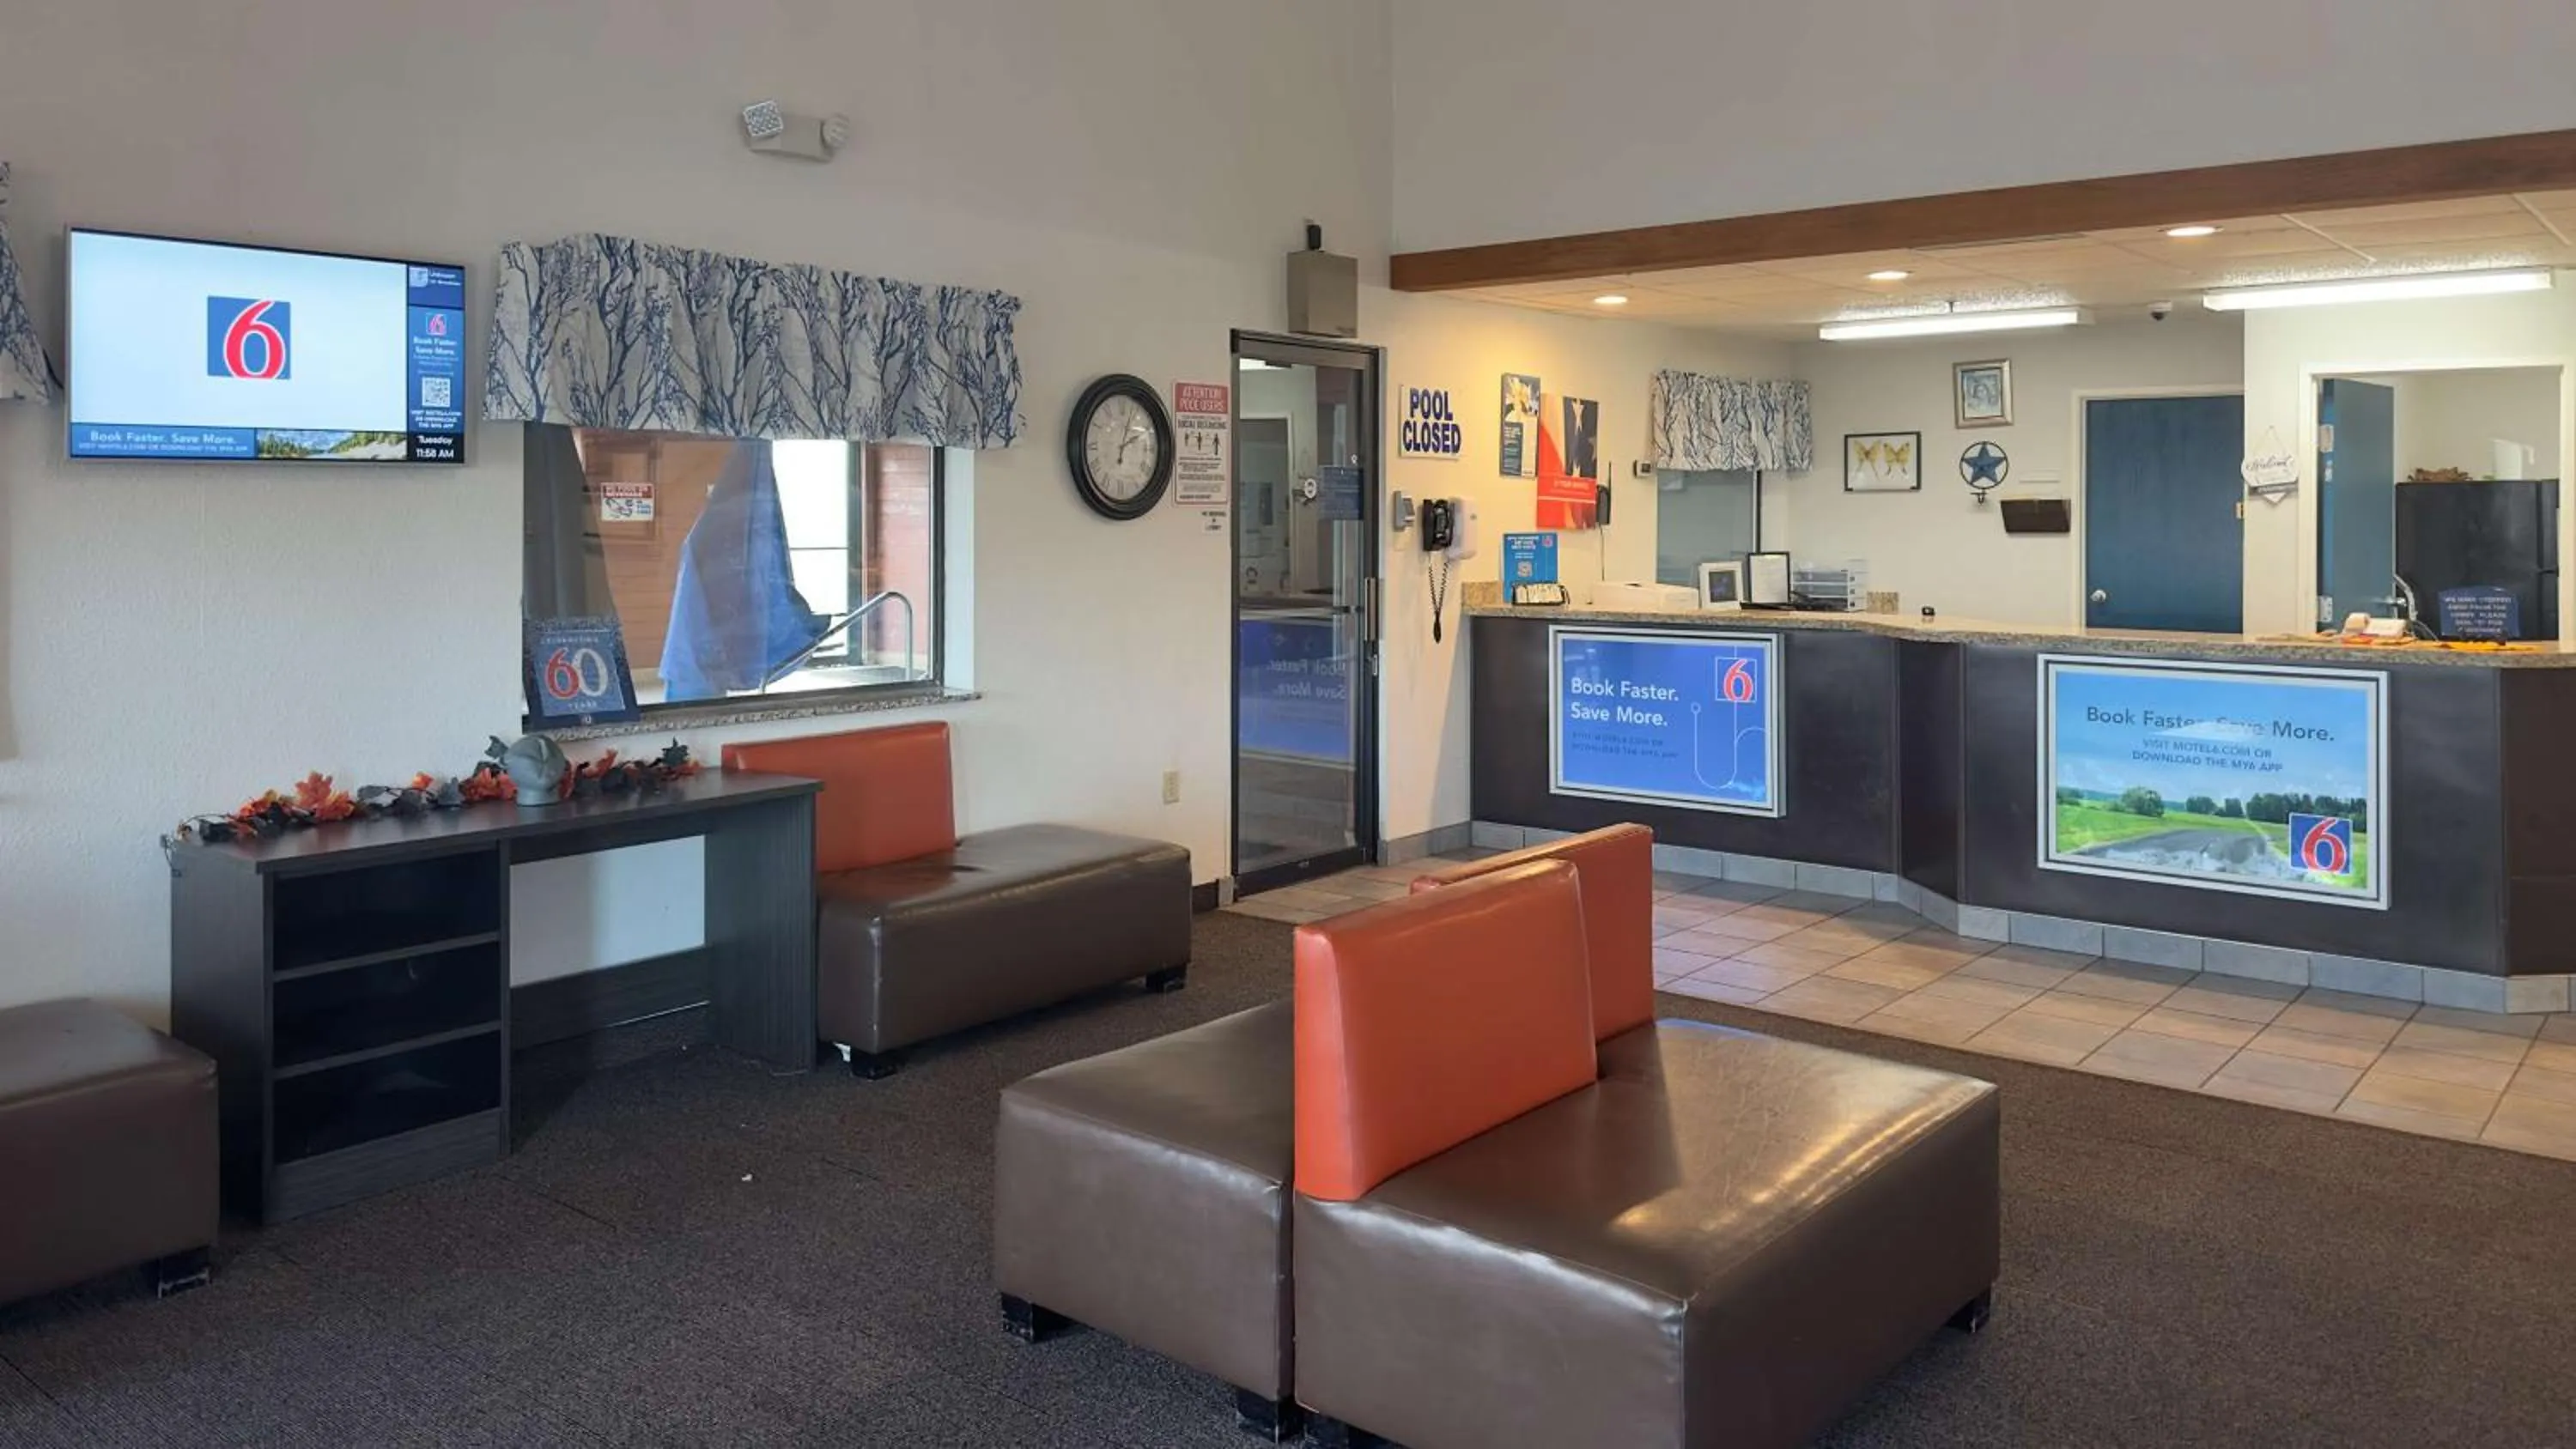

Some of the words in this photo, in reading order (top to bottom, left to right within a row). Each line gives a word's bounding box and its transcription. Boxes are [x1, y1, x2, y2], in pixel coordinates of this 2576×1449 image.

[224, 299, 285, 379] 6
[1410, 388, 1453, 421] POOL
[90, 430, 122, 442] Book
[126, 432, 168, 443] Faster.
[172, 433, 198, 444] Save
[202, 433, 238, 445] More.
[417, 435, 453, 446] Tuesday
[1402, 420, 1461, 453] CLOSED
[438, 449, 454, 458] AM
[545, 647, 609, 700] 60
[1723, 658, 1754, 702] 6
[1571, 677, 1614, 697] Book
[1620, 681, 1680, 701] Faster.
[1571, 701, 1610, 721] Save
[1616, 705, 1668, 727] More.
[2087, 706, 2136, 725] Book
[2143, 711, 2203, 729] Faste
[2272, 720, 2335, 741] More.
[2132, 750, 2202, 766] DOWNLOAD
[2206, 756, 2227, 768] THE
[2259, 762, 2283, 772] APP
[2143, 739, 2169, 750] VISIT
[2173, 741, 2251, 756] MOTEL6.COM
[2254, 749, 2272, 758] OR
[2301, 817, 2348, 875] 6
